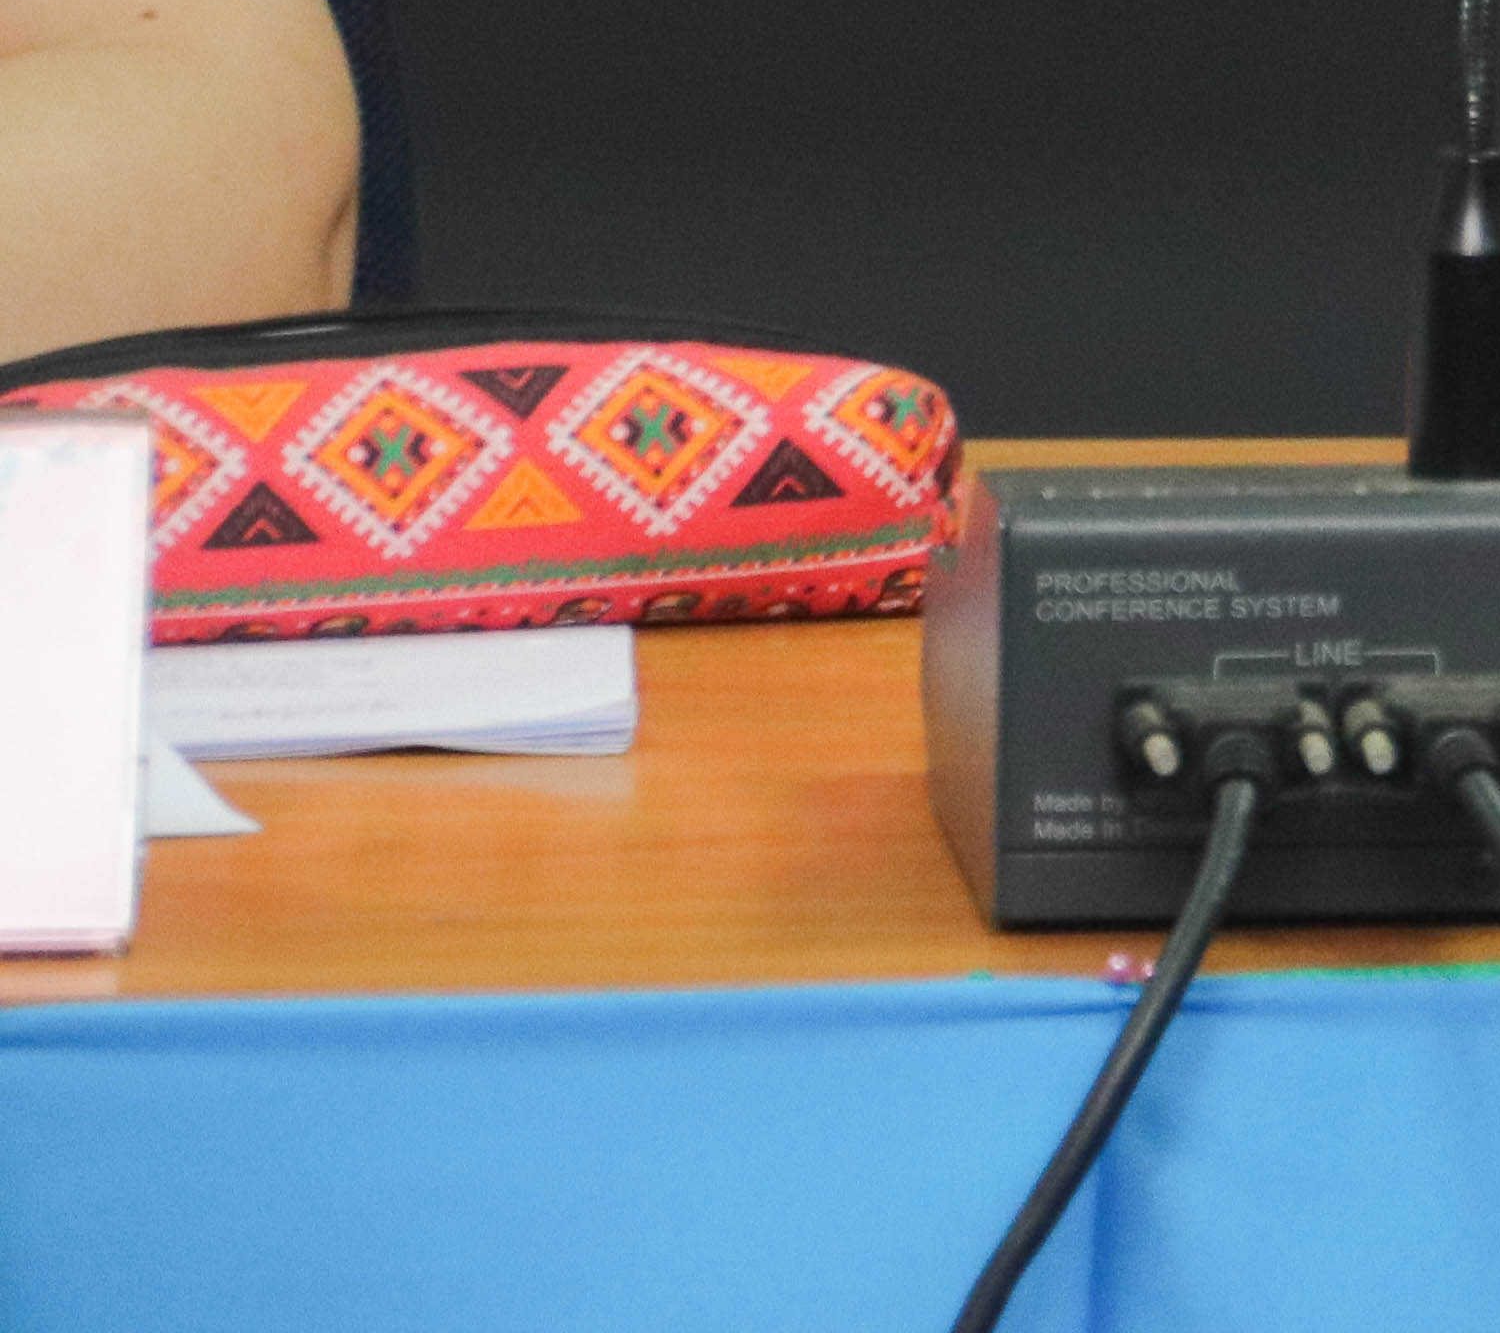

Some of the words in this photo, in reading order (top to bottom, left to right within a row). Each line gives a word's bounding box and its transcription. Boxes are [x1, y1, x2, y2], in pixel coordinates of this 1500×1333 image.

[1036, 570, 1240, 593] PROFESSIONAL
[1036, 597, 1221, 621] CONFERENCE
[1231, 595, 1340, 619] SYSTEM
[1295, 639, 1363, 667] LINE
[1034, 793, 1093, 813] Made
[1034, 819, 1094, 840] Made
